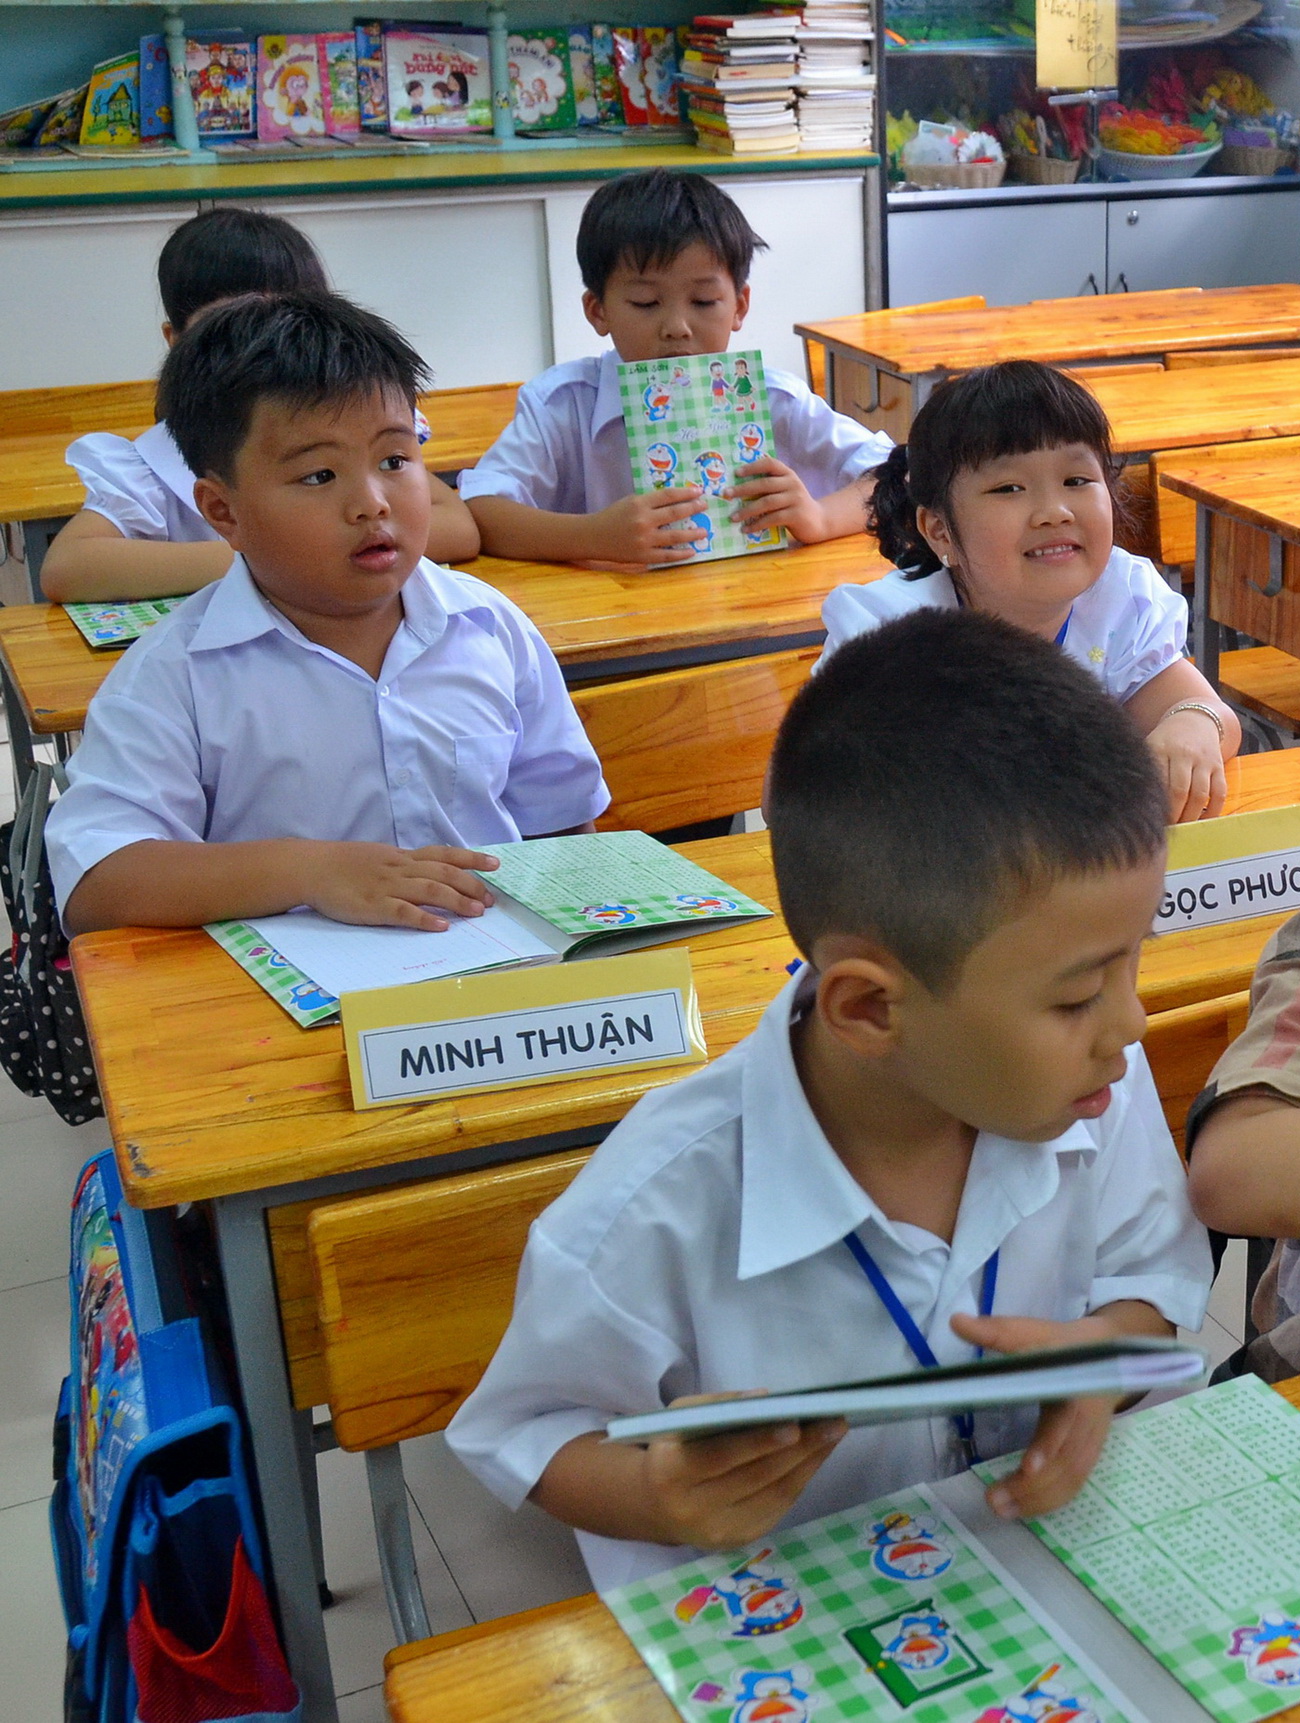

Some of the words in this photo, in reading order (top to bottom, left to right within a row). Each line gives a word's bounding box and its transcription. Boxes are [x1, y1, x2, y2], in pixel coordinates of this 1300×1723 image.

[1157, 882, 1219, 921] GỌC
[400, 1035, 505, 1079] MINH
[516, 1012, 654, 1061] THUẬN
